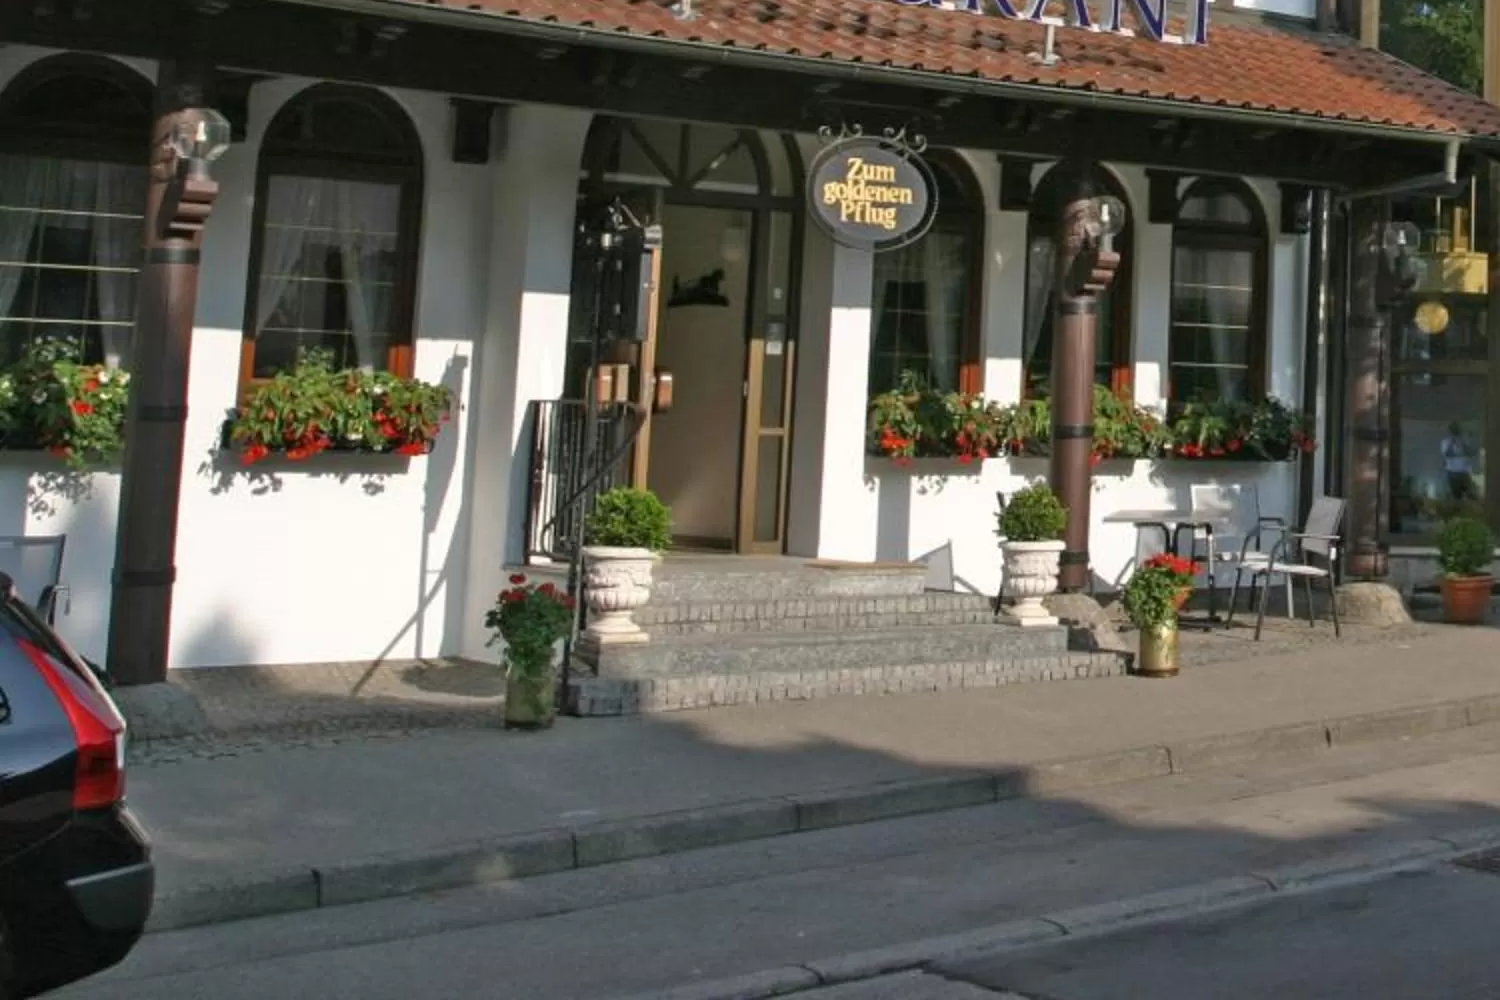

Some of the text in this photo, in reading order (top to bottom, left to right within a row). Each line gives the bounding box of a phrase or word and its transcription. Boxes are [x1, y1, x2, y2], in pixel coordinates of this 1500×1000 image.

[846, 157, 896, 182] Zum
[822, 180, 913, 205] goldenen
[839, 200, 898, 229] Pflug
